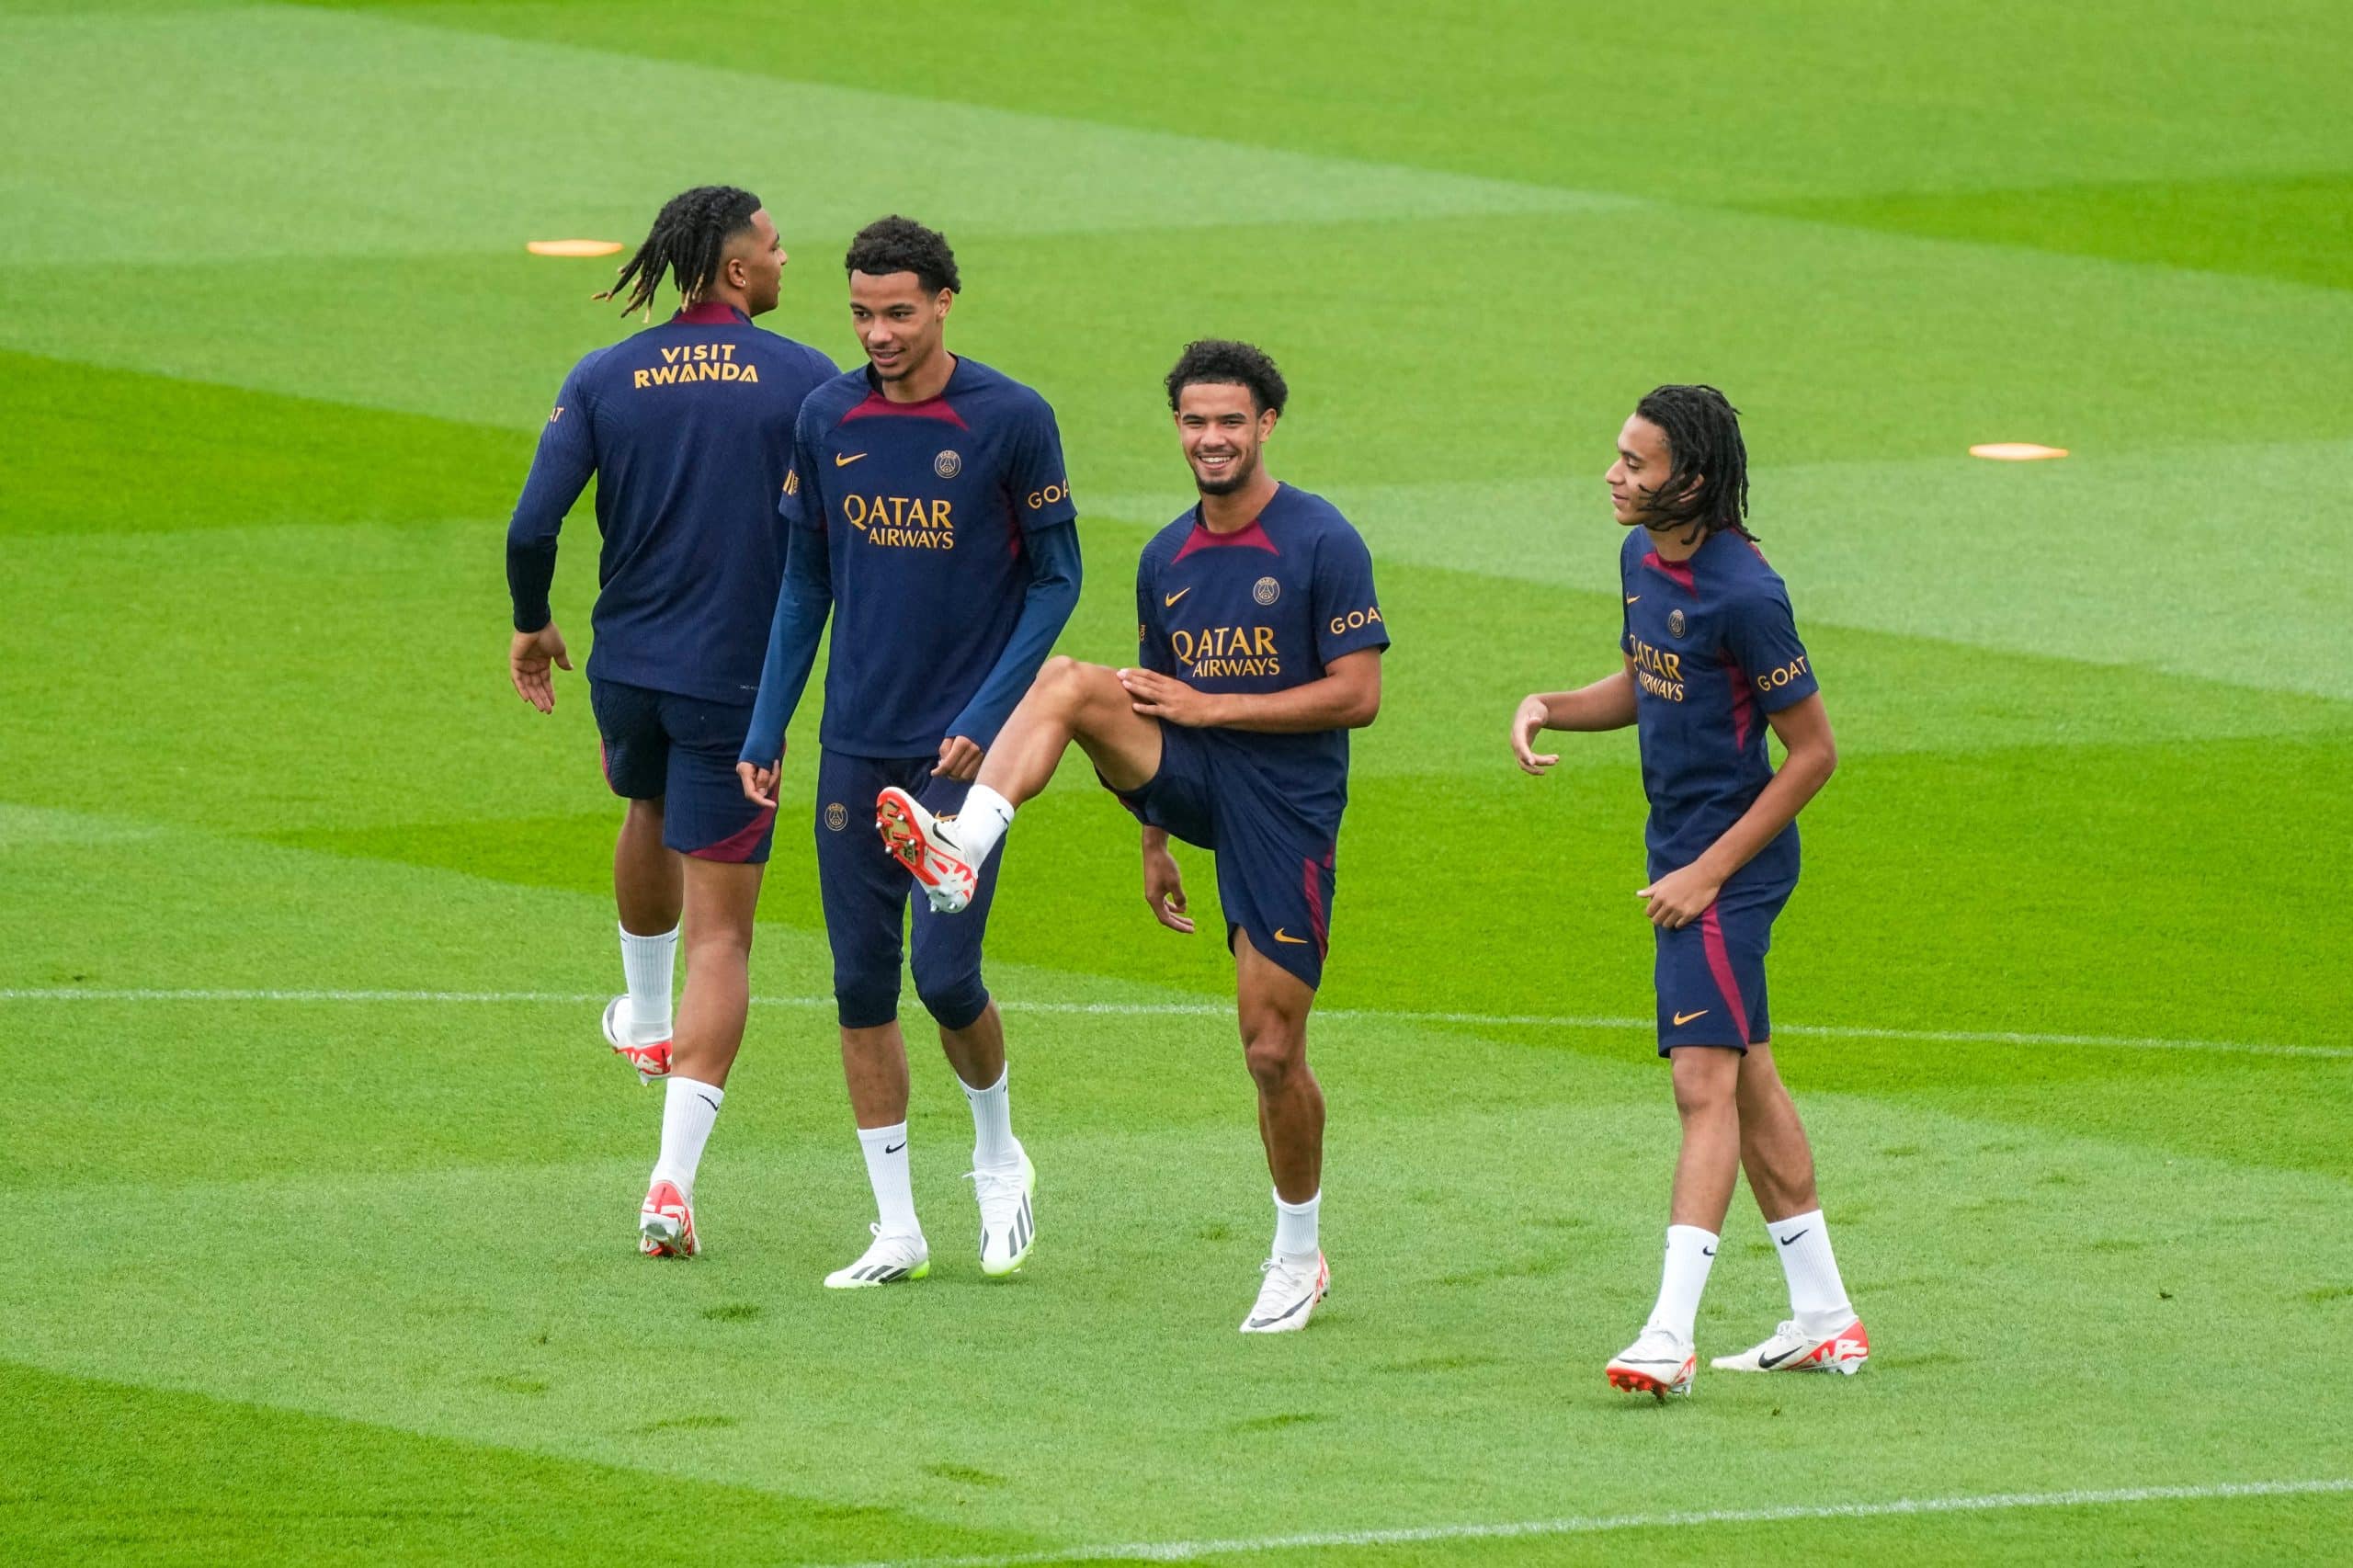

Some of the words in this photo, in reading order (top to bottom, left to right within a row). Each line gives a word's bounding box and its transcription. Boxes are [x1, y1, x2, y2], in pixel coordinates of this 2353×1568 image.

[661, 344, 735, 364] VISIT
[633, 362, 759, 389] RWANDA
[1028, 478, 1069, 509] GOA
[844, 494, 954, 531] QATAR
[869, 527, 954, 550] AIRWAYS
[1330, 606, 1382, 635] GOA
[1171, 626, 1279, 666] QATAR
[1192, 656, 1280, 677] AIRWAYS
[1756, 655, 1807, 692] GOAT
